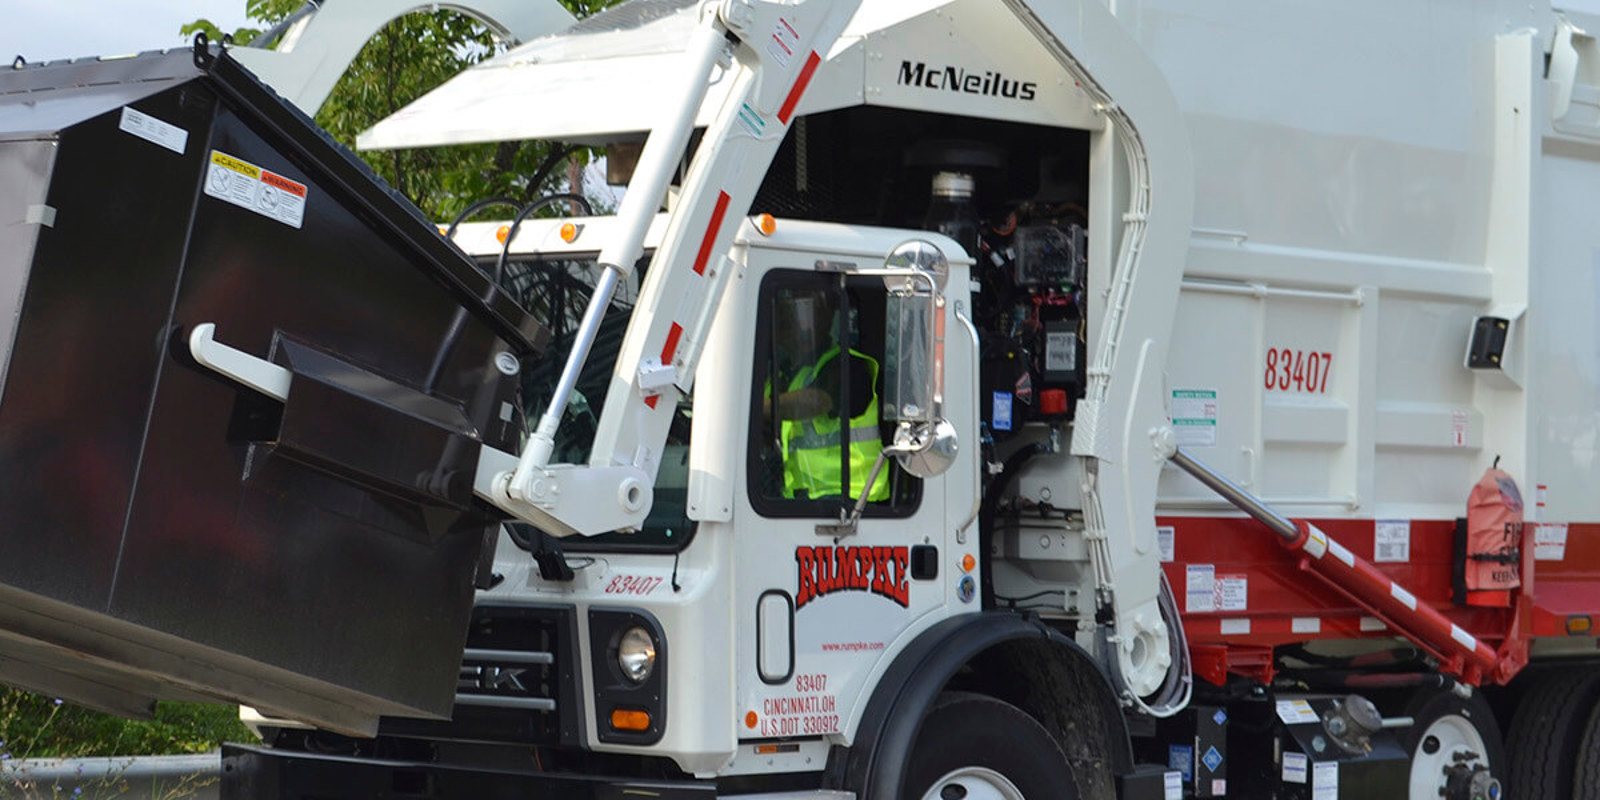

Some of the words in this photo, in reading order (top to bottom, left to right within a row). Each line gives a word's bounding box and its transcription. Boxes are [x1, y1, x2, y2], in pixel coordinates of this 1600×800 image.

[897, 60, 1037, 100] McNeilus
[1264, 348, 1332, 394] 83407
[605, 575, 663, 595] 83407
[795, 546, 909, 611] RUMPKE
[822, 642, 884, 654] www.rumpke.com
[796, 674, 827, 692] 83407
[803, 715, 839, 734] 330912
